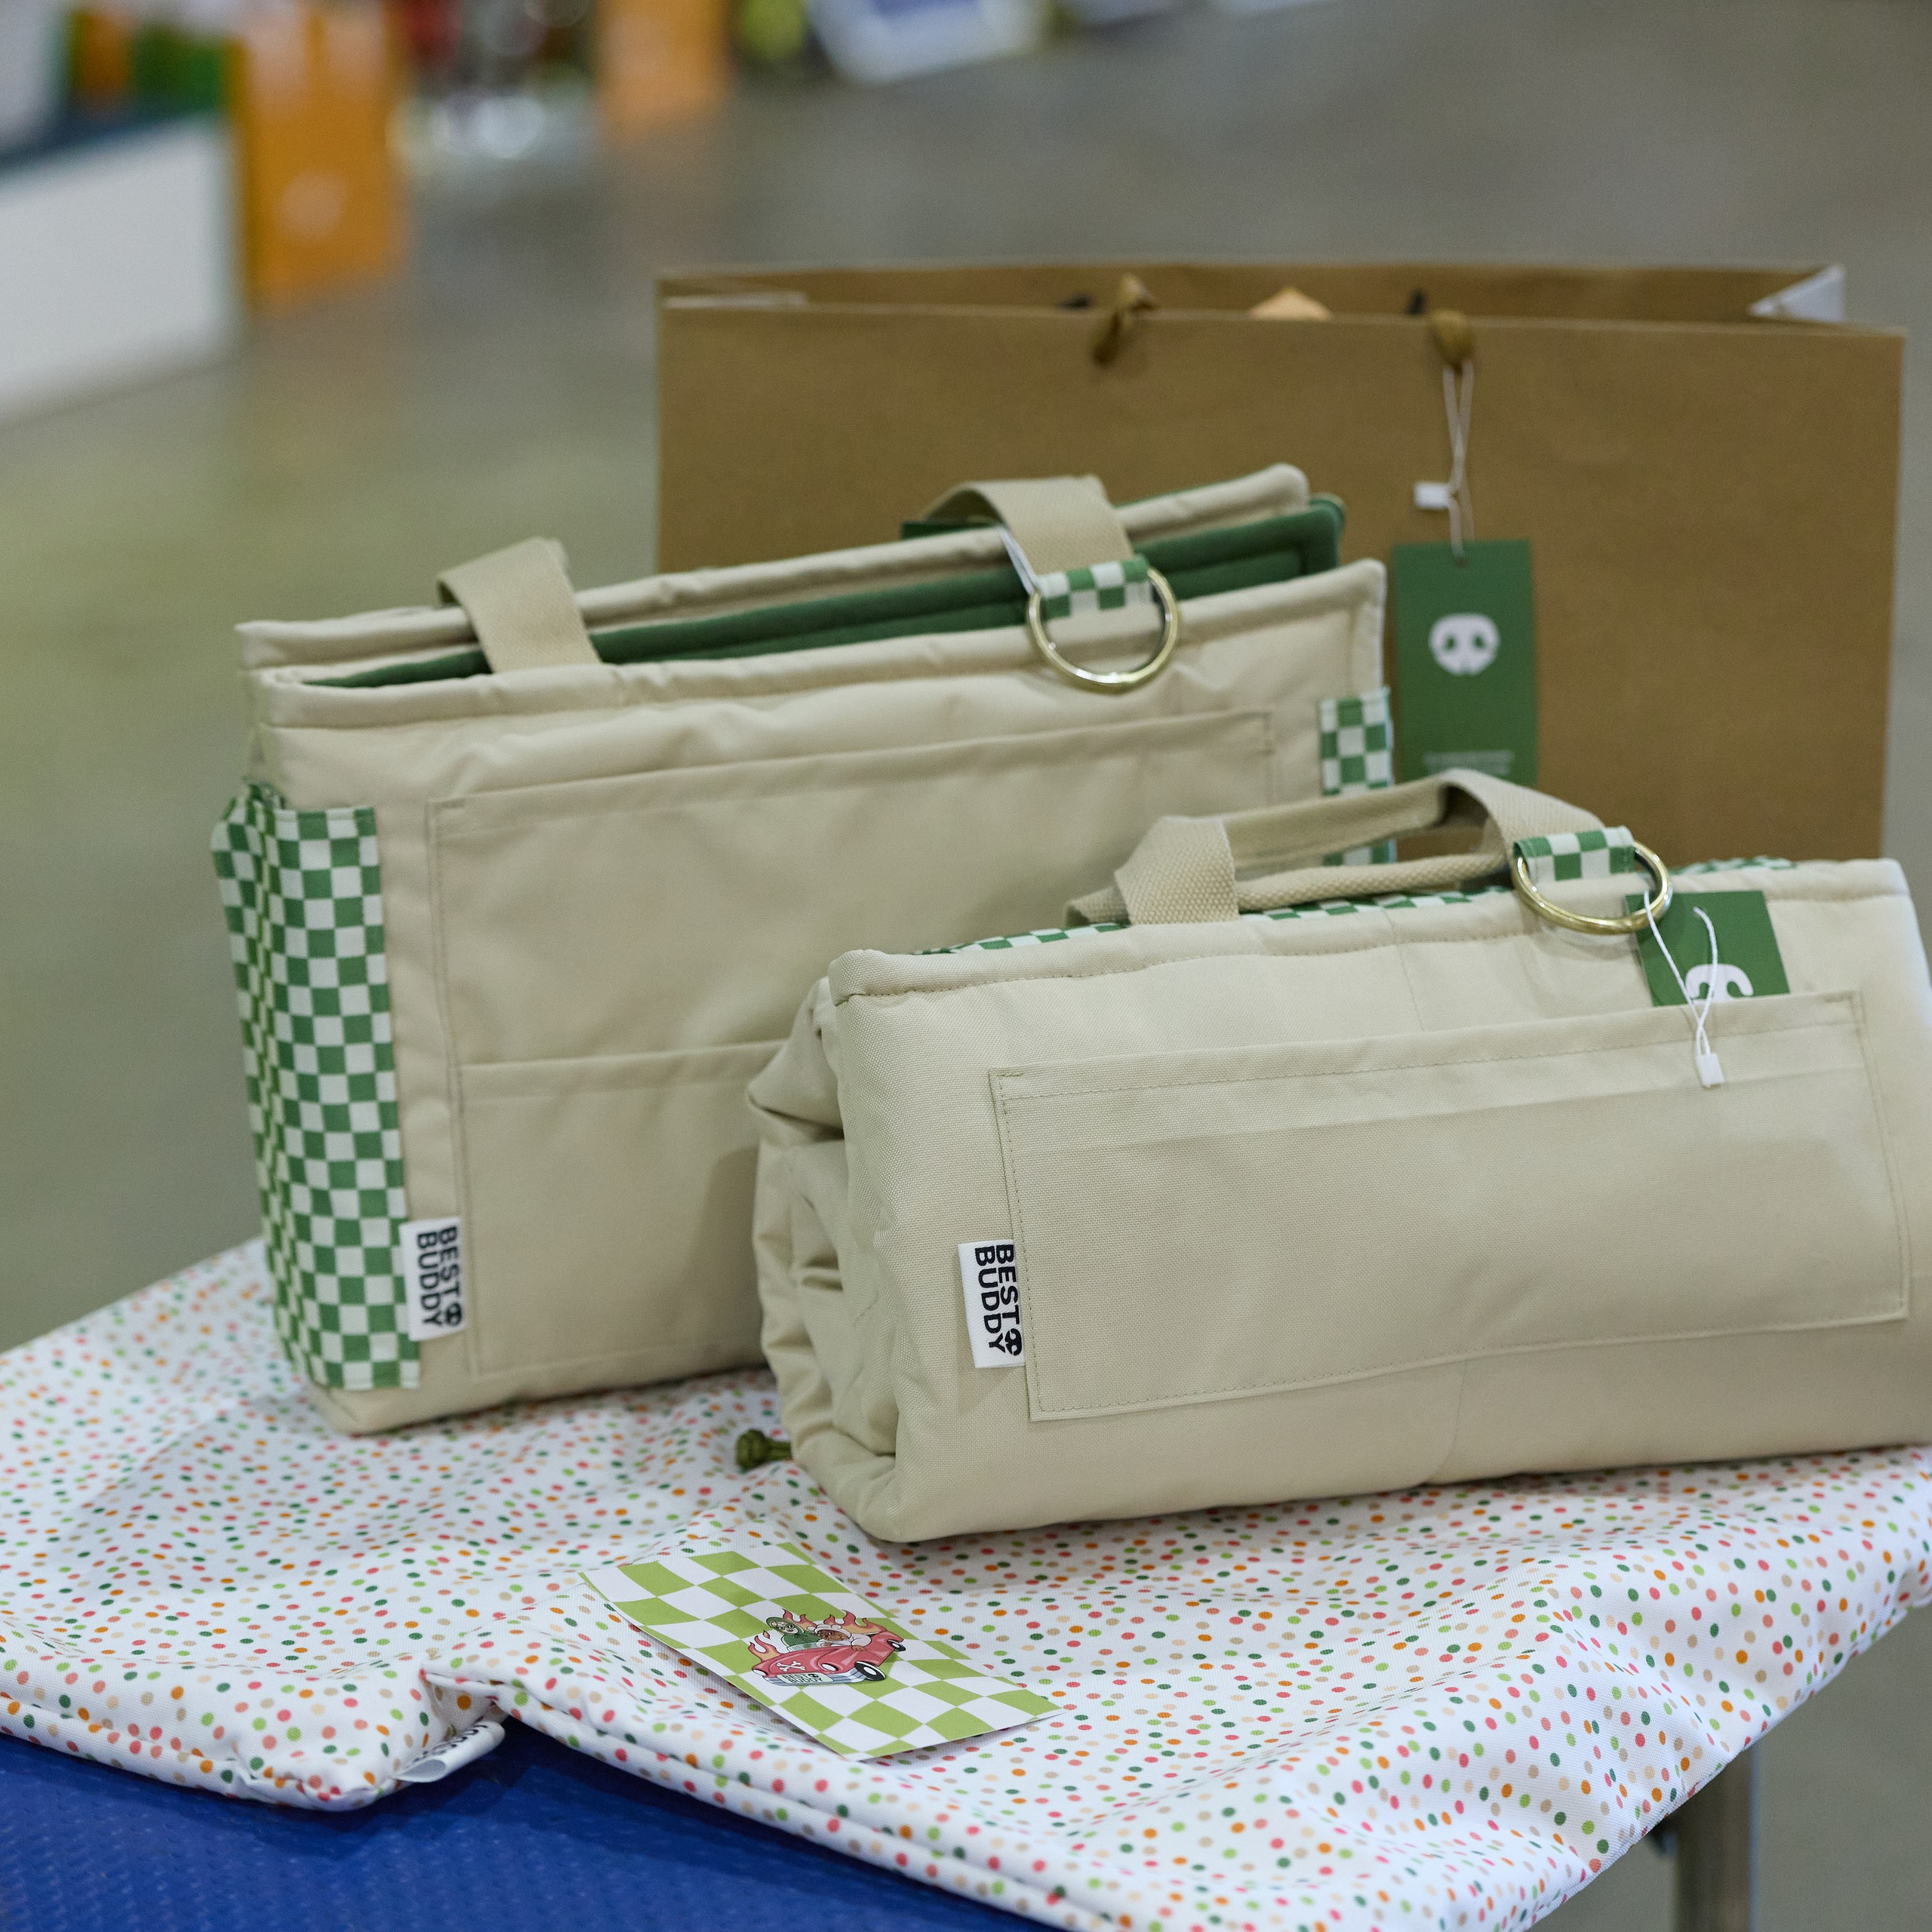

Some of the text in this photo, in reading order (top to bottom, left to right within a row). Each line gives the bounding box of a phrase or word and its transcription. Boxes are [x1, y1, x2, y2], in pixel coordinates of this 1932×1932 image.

[417, 1231, 443, 1327] BUDDY
[438, 1226, 460, 1297] BEST
[975, 1246, 1006, 1353] BUDDY
[996, 1244, 1020, 1324] BEST
